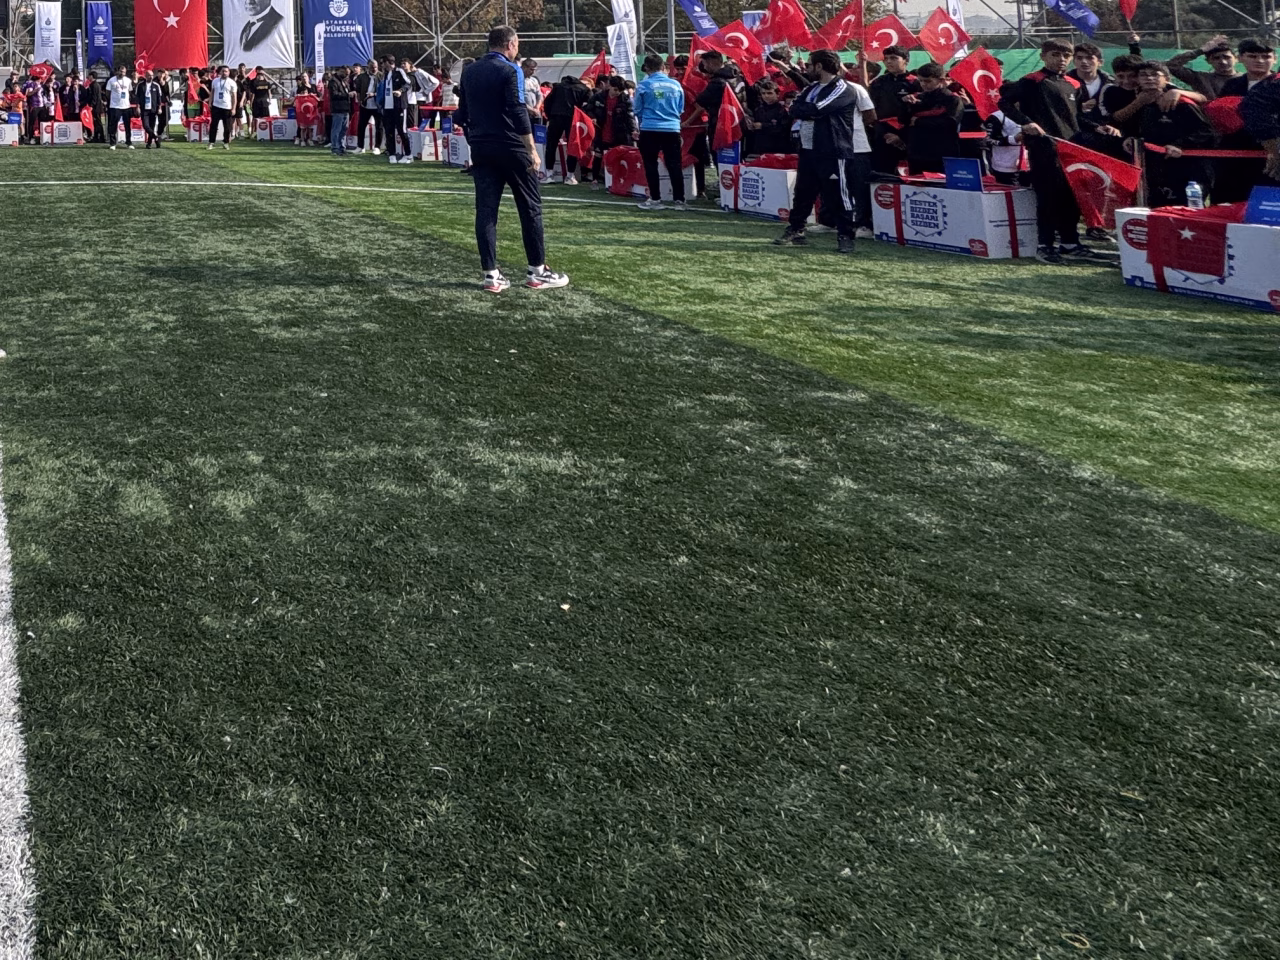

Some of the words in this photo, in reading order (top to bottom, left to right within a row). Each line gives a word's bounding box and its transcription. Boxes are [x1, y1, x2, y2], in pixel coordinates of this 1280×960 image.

[909, 199, 938, 208] DESTEK
[910, 206, 938, 215] BİZDEN
[910, 213, 938, 222] BAŞARI
[910, 220, 939, 229] SİZDEN
